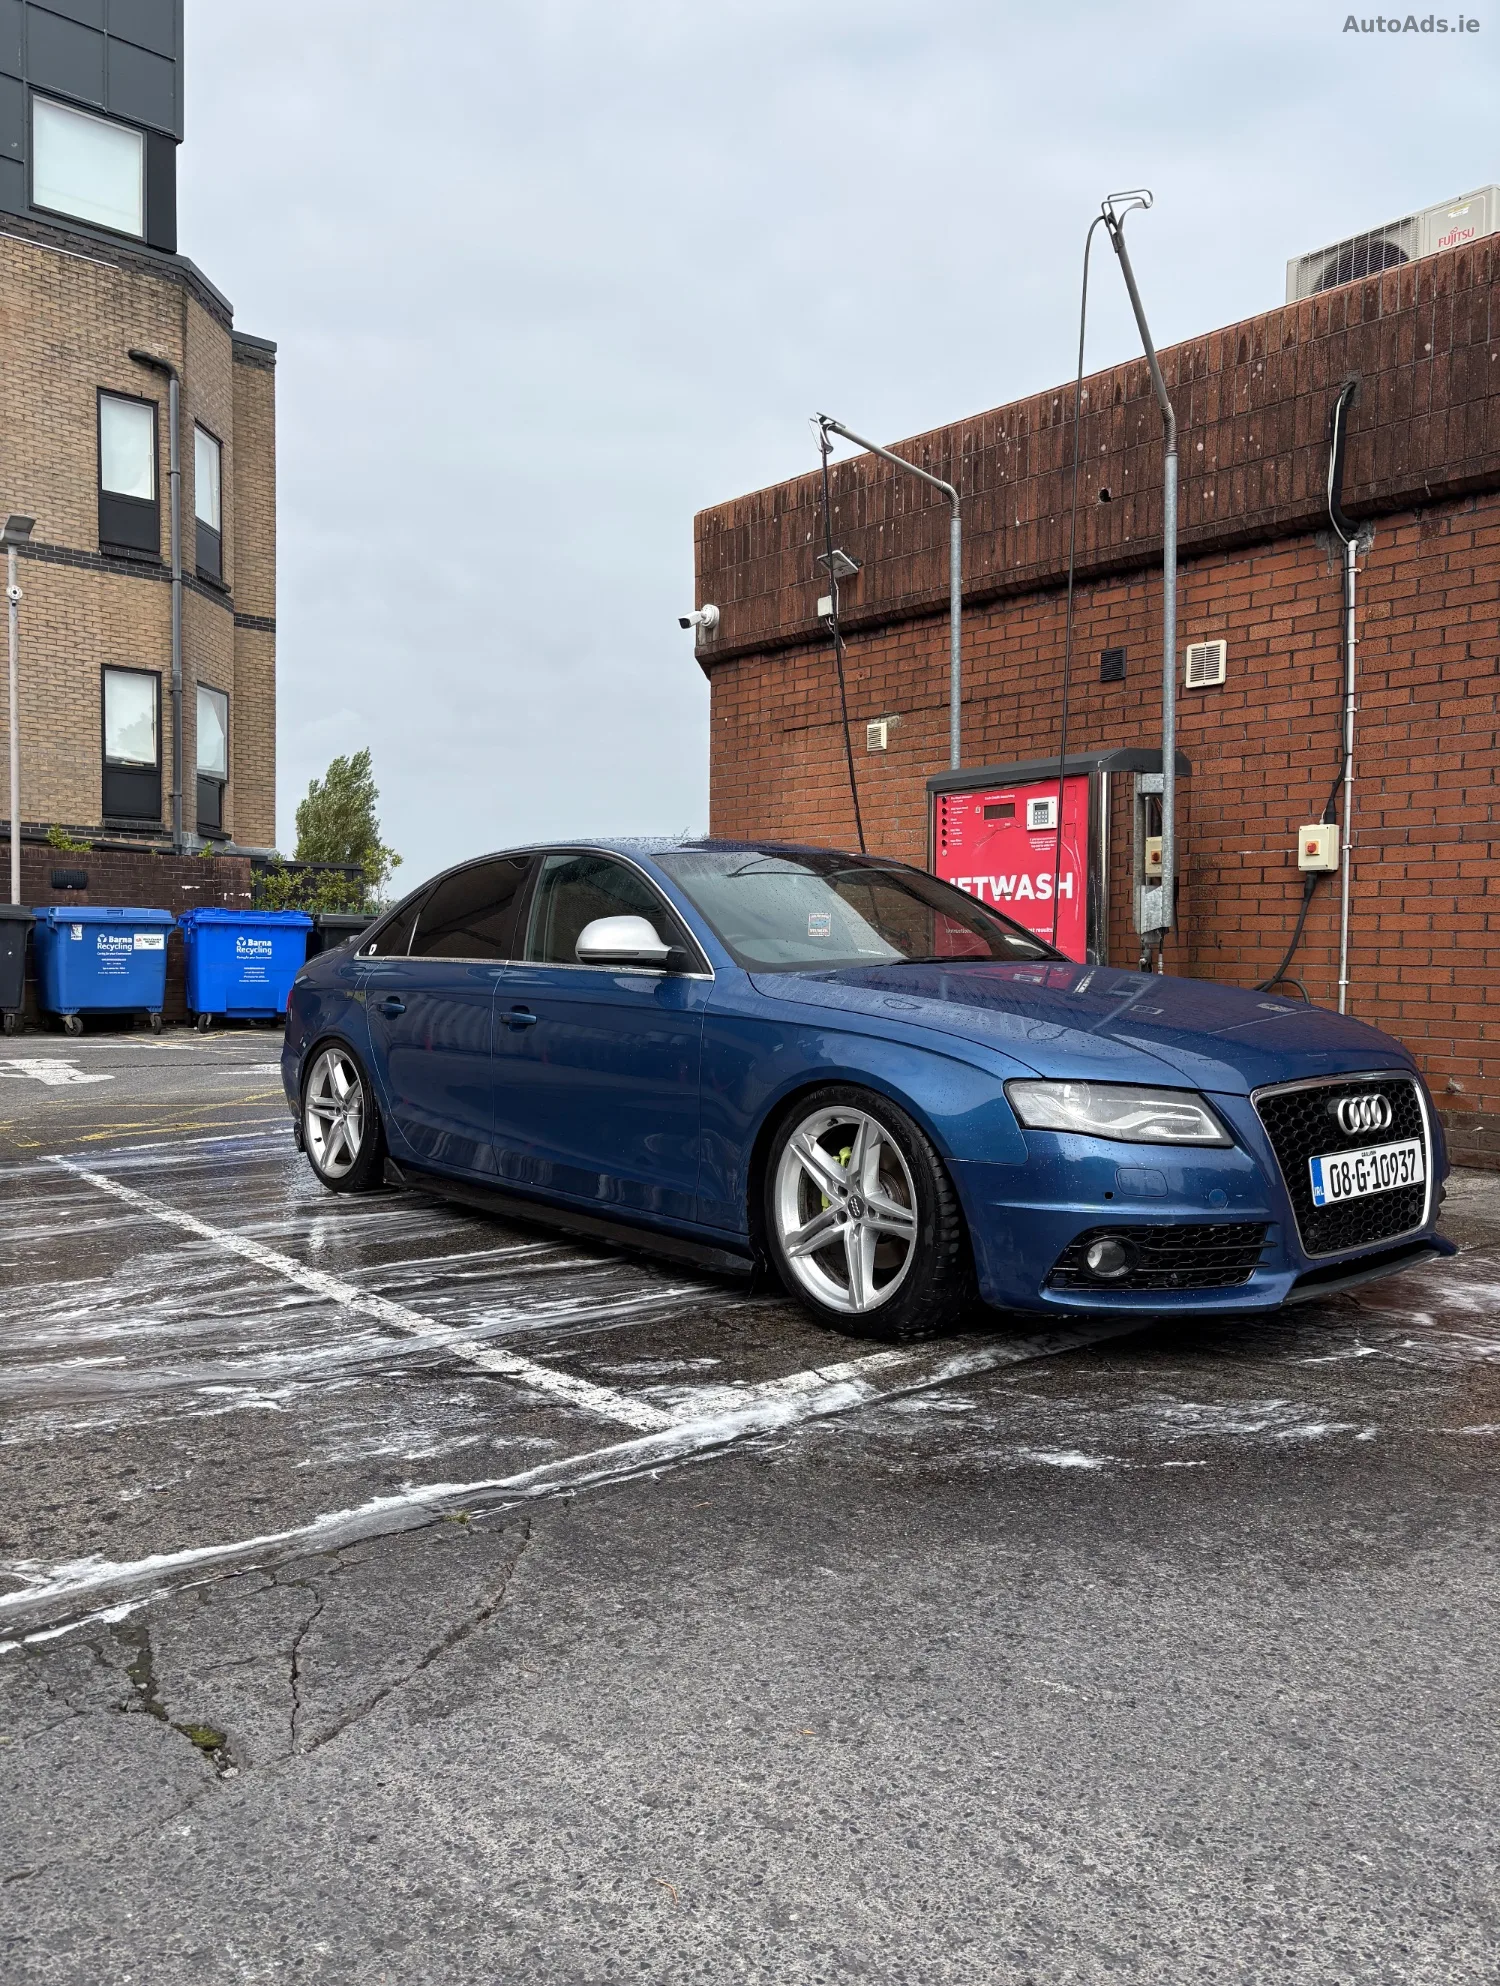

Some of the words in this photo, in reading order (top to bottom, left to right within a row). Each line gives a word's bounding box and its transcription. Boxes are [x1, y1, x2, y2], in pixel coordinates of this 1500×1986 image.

[1438, 227, 1475, 247] FUJITSU
[97, 943, 133, 951] Recycling
[236, 946, 272, 955] Recycling
